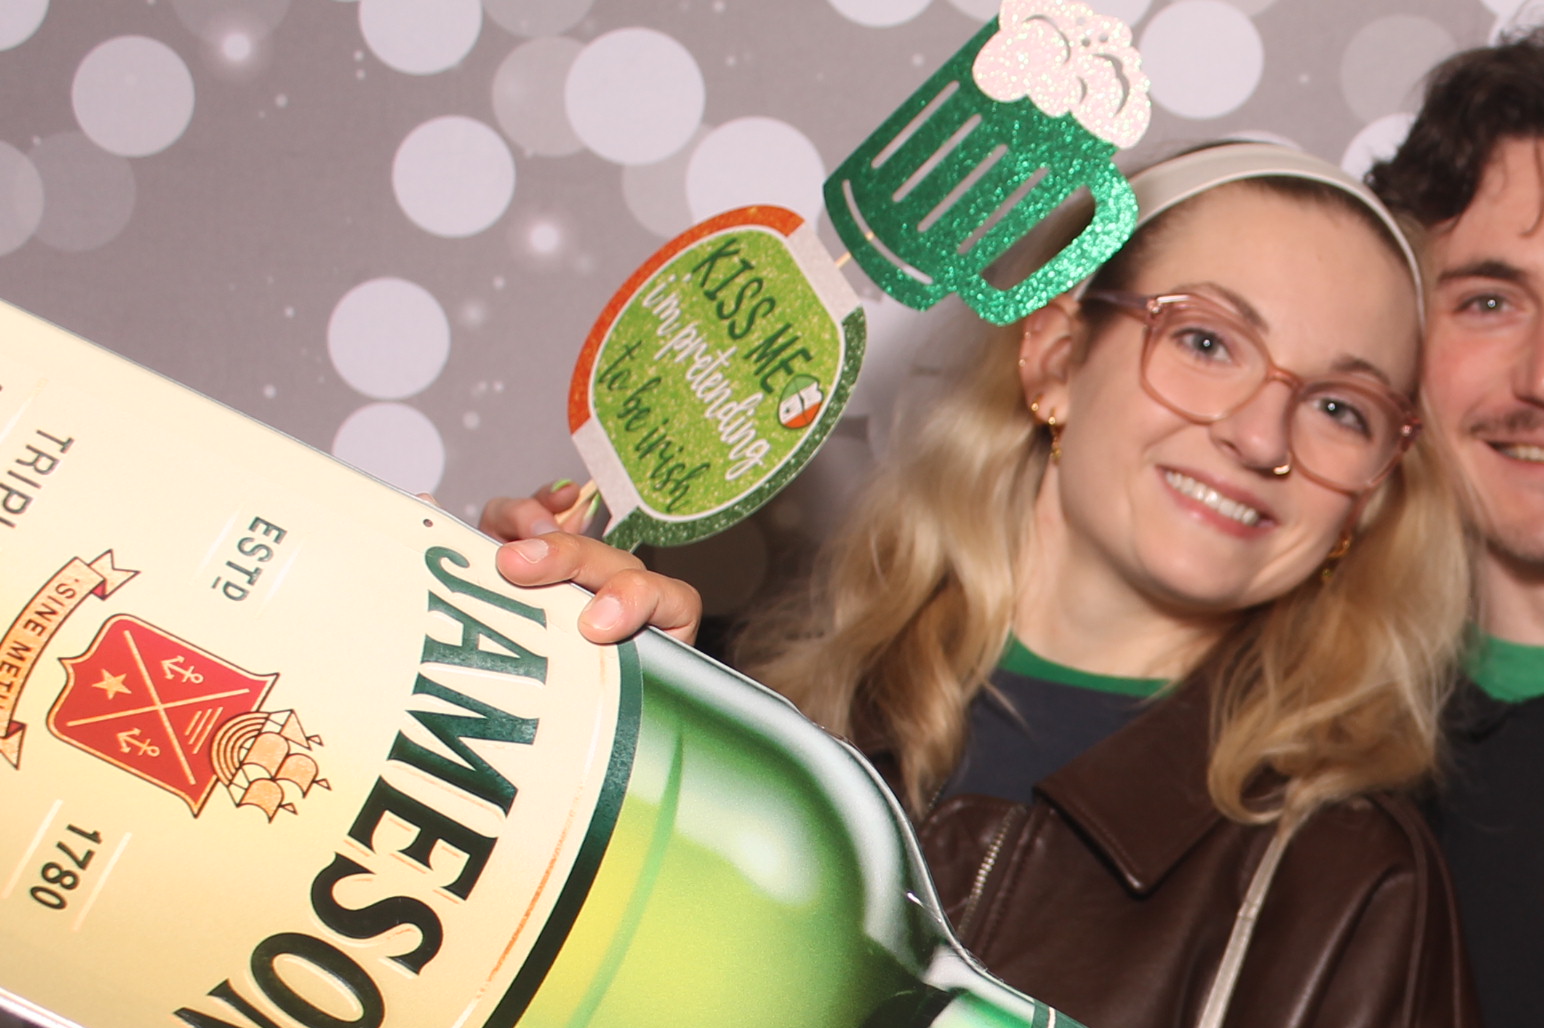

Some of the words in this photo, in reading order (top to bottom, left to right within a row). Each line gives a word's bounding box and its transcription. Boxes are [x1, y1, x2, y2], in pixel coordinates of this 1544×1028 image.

[690, 237, 777, 341] KISS
[743, 322, 814, 395] ME
[598, 340, 642, 392] to
[618, 376, 662, 432] be
[653, 322, 772, 481] pretending
[635, 417, 711, 513] irish
[210, 515, 288, 602] ESTD
[23, 582, 77, 637] SINE
[0, 640, 32, 710] MET
[29, 823, 103, 911] 1780
